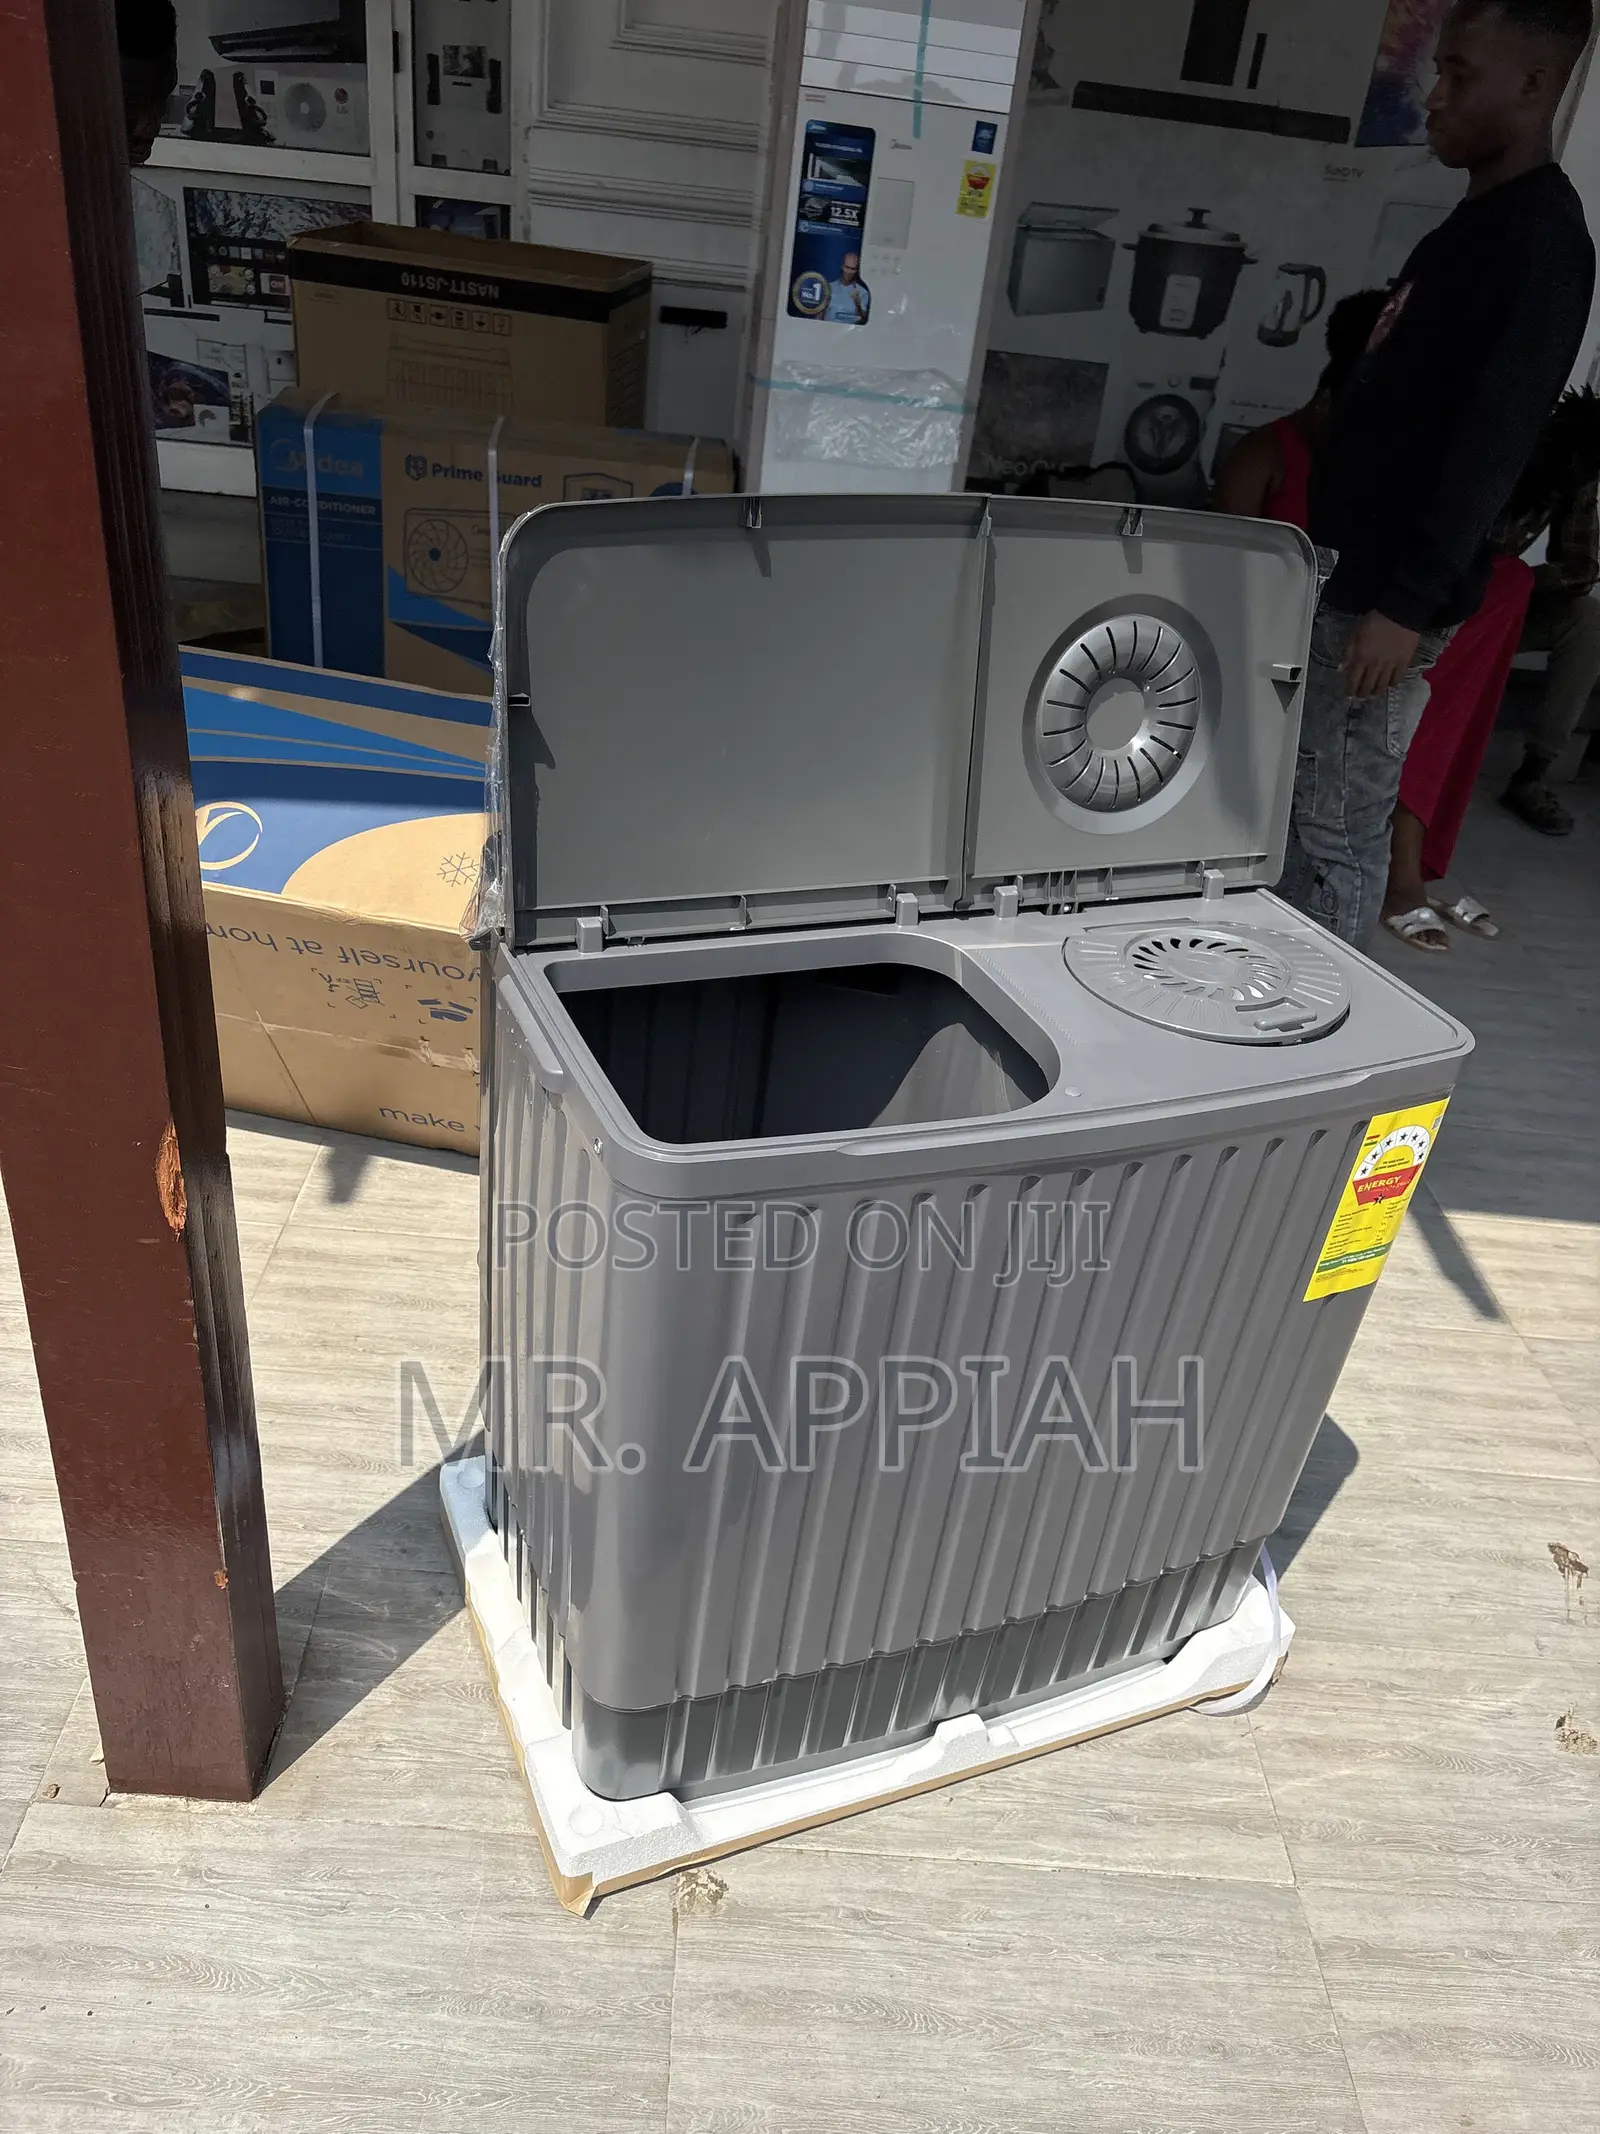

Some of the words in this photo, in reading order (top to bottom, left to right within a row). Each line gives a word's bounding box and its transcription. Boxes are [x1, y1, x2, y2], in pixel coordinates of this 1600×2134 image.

[282, 447, 365, 478] Mdea
[431, 462, 484, 483] Prime
[496, 469, 543, 488] uard
[206, 922, 279, 952] hom
[285, 936, 324, 955] at
[379, 1107, 466, 1132] make
[1357, 1176, 1403, 1192] ENERGY
